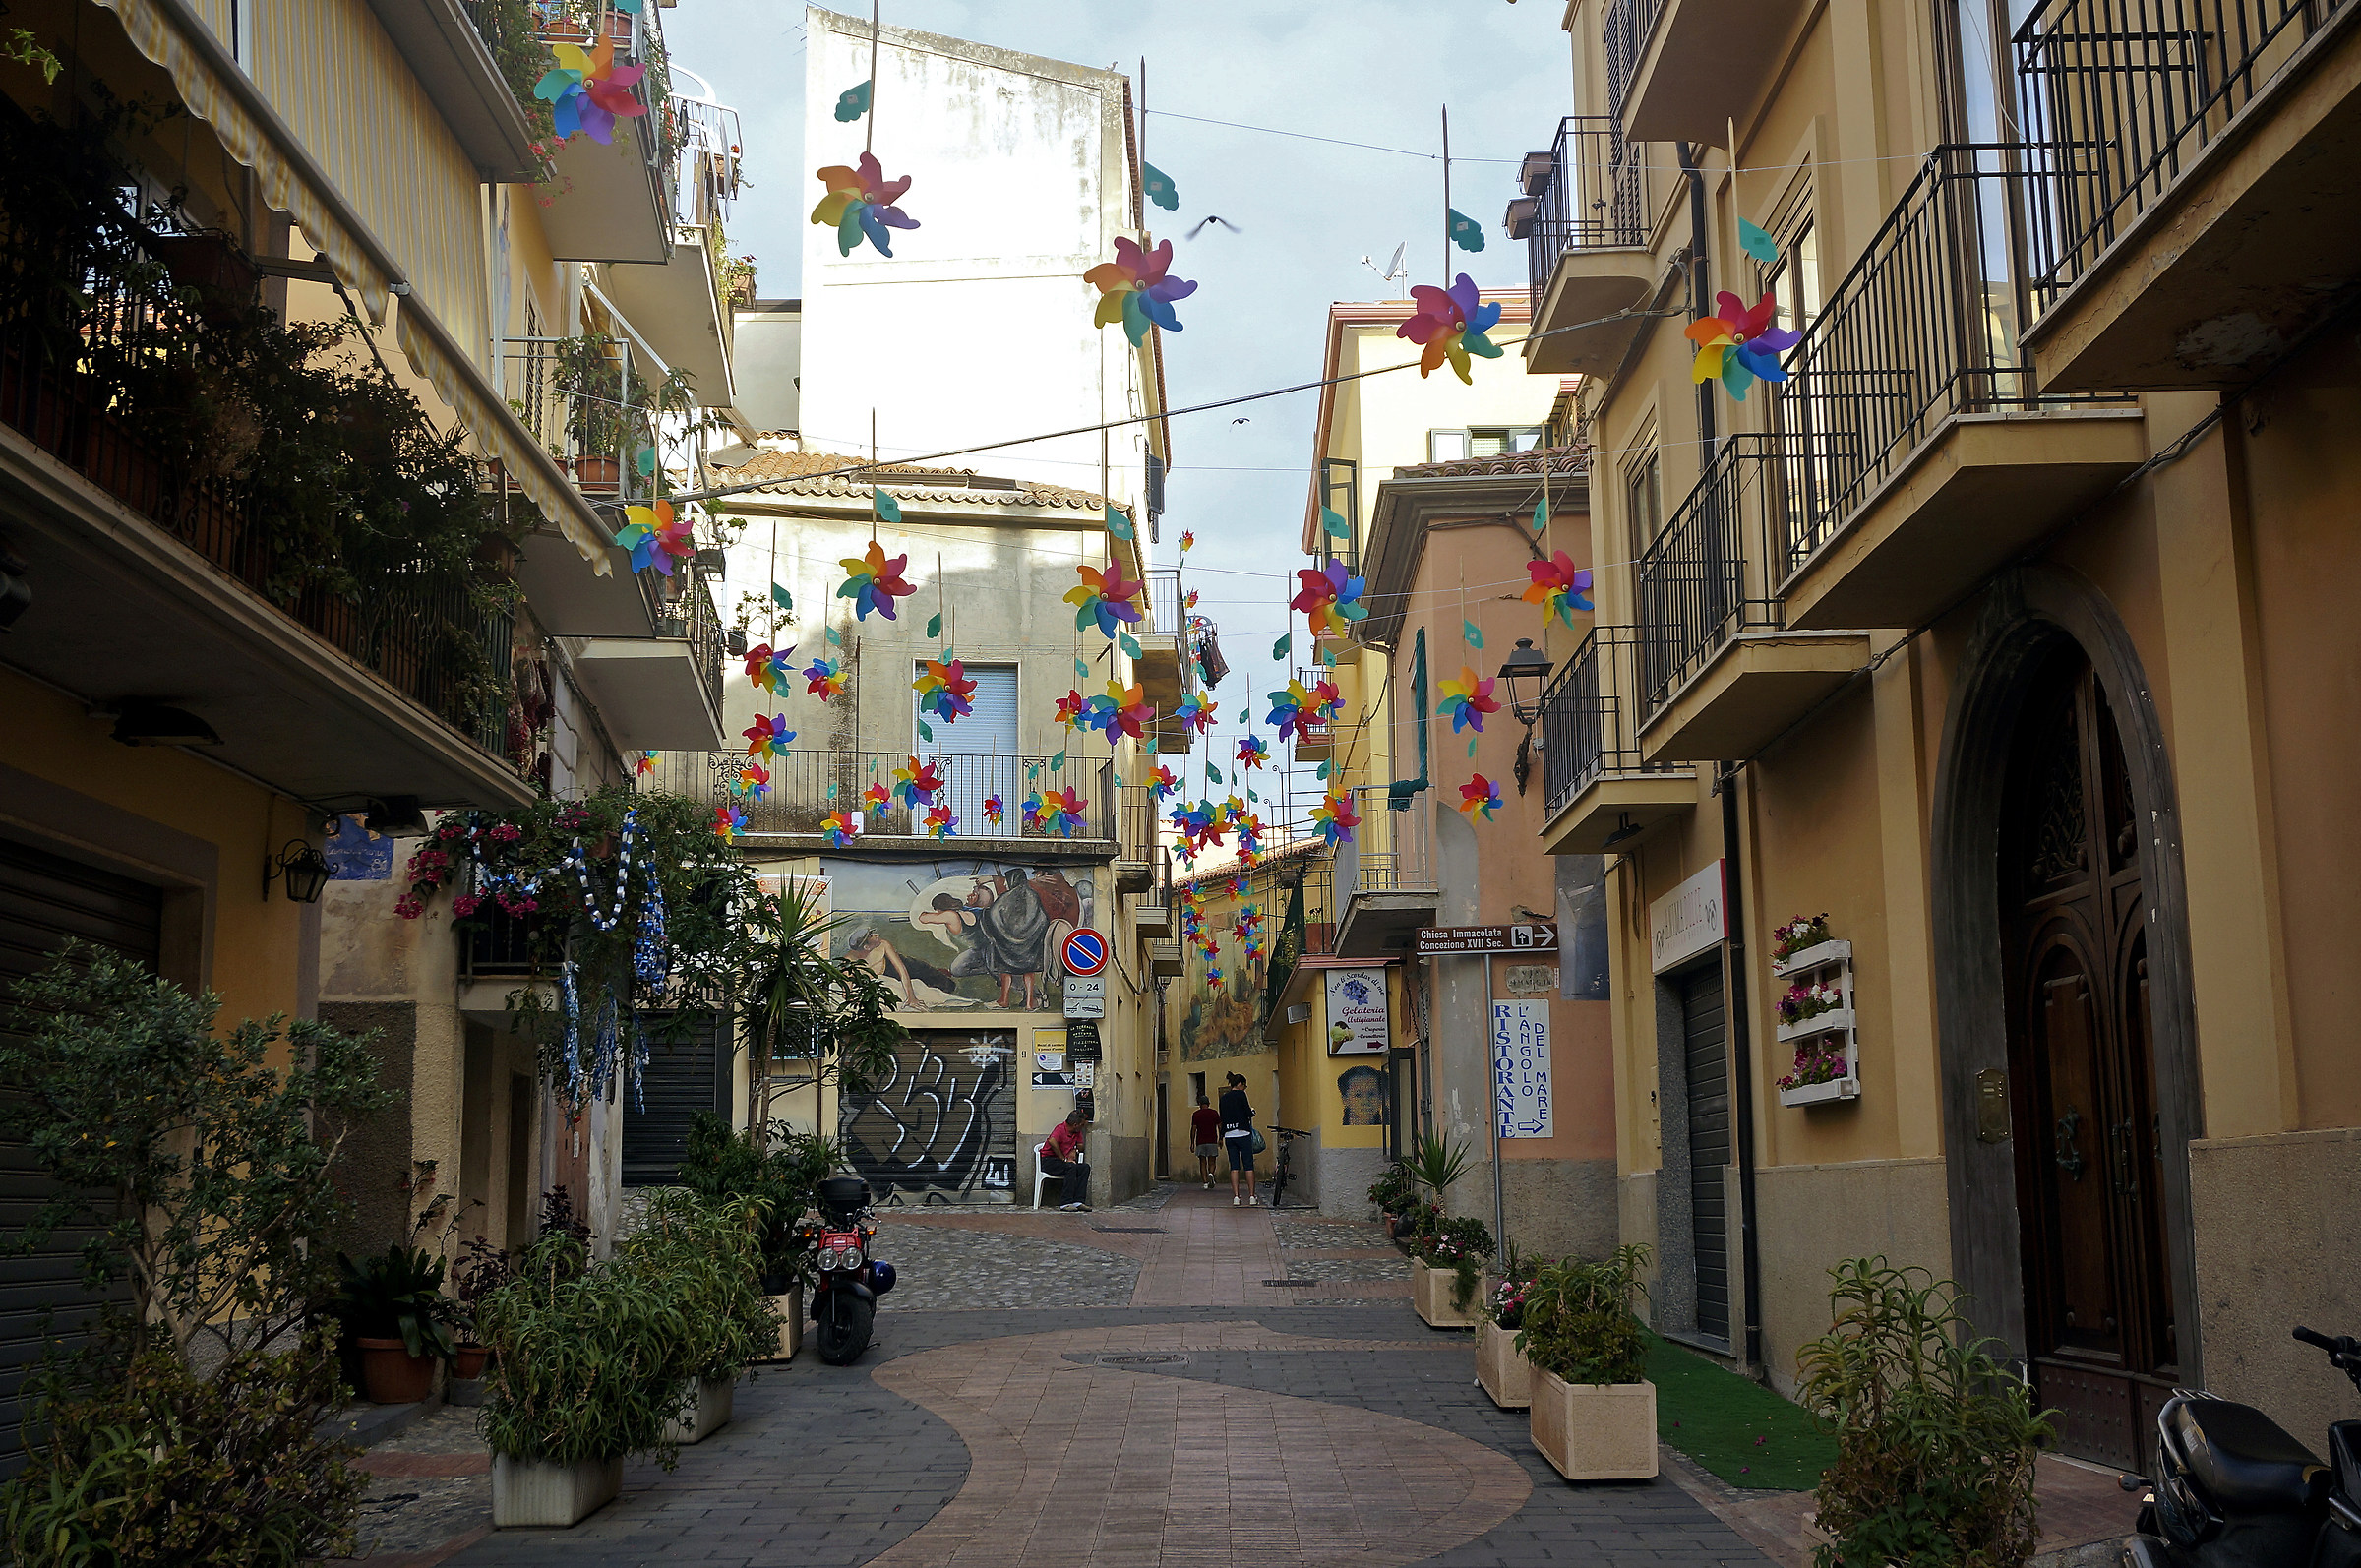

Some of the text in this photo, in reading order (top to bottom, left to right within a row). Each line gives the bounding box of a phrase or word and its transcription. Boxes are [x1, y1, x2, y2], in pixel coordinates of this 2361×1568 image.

[1421, 928, 1502, 939] Chiesa Immacolata
[1420, 938, 1504, 950] Concezione XVII Sec.
[1346, 972, 1370, 982] Scordar
[1069, 983, 1077, 992] 0
[1086, 983, 1100, 992] 24
[1342, 1006, 1385, 1017] Gelateria
[1347, 1015, 1386, 1025] Artigianale
[1519, 1006, 1534, 1097] L'ANGOLO
[1494, 1005, 1516, 1138] RISTORANTE
[1534, 1022, 1548, 1119] DEL MARE
